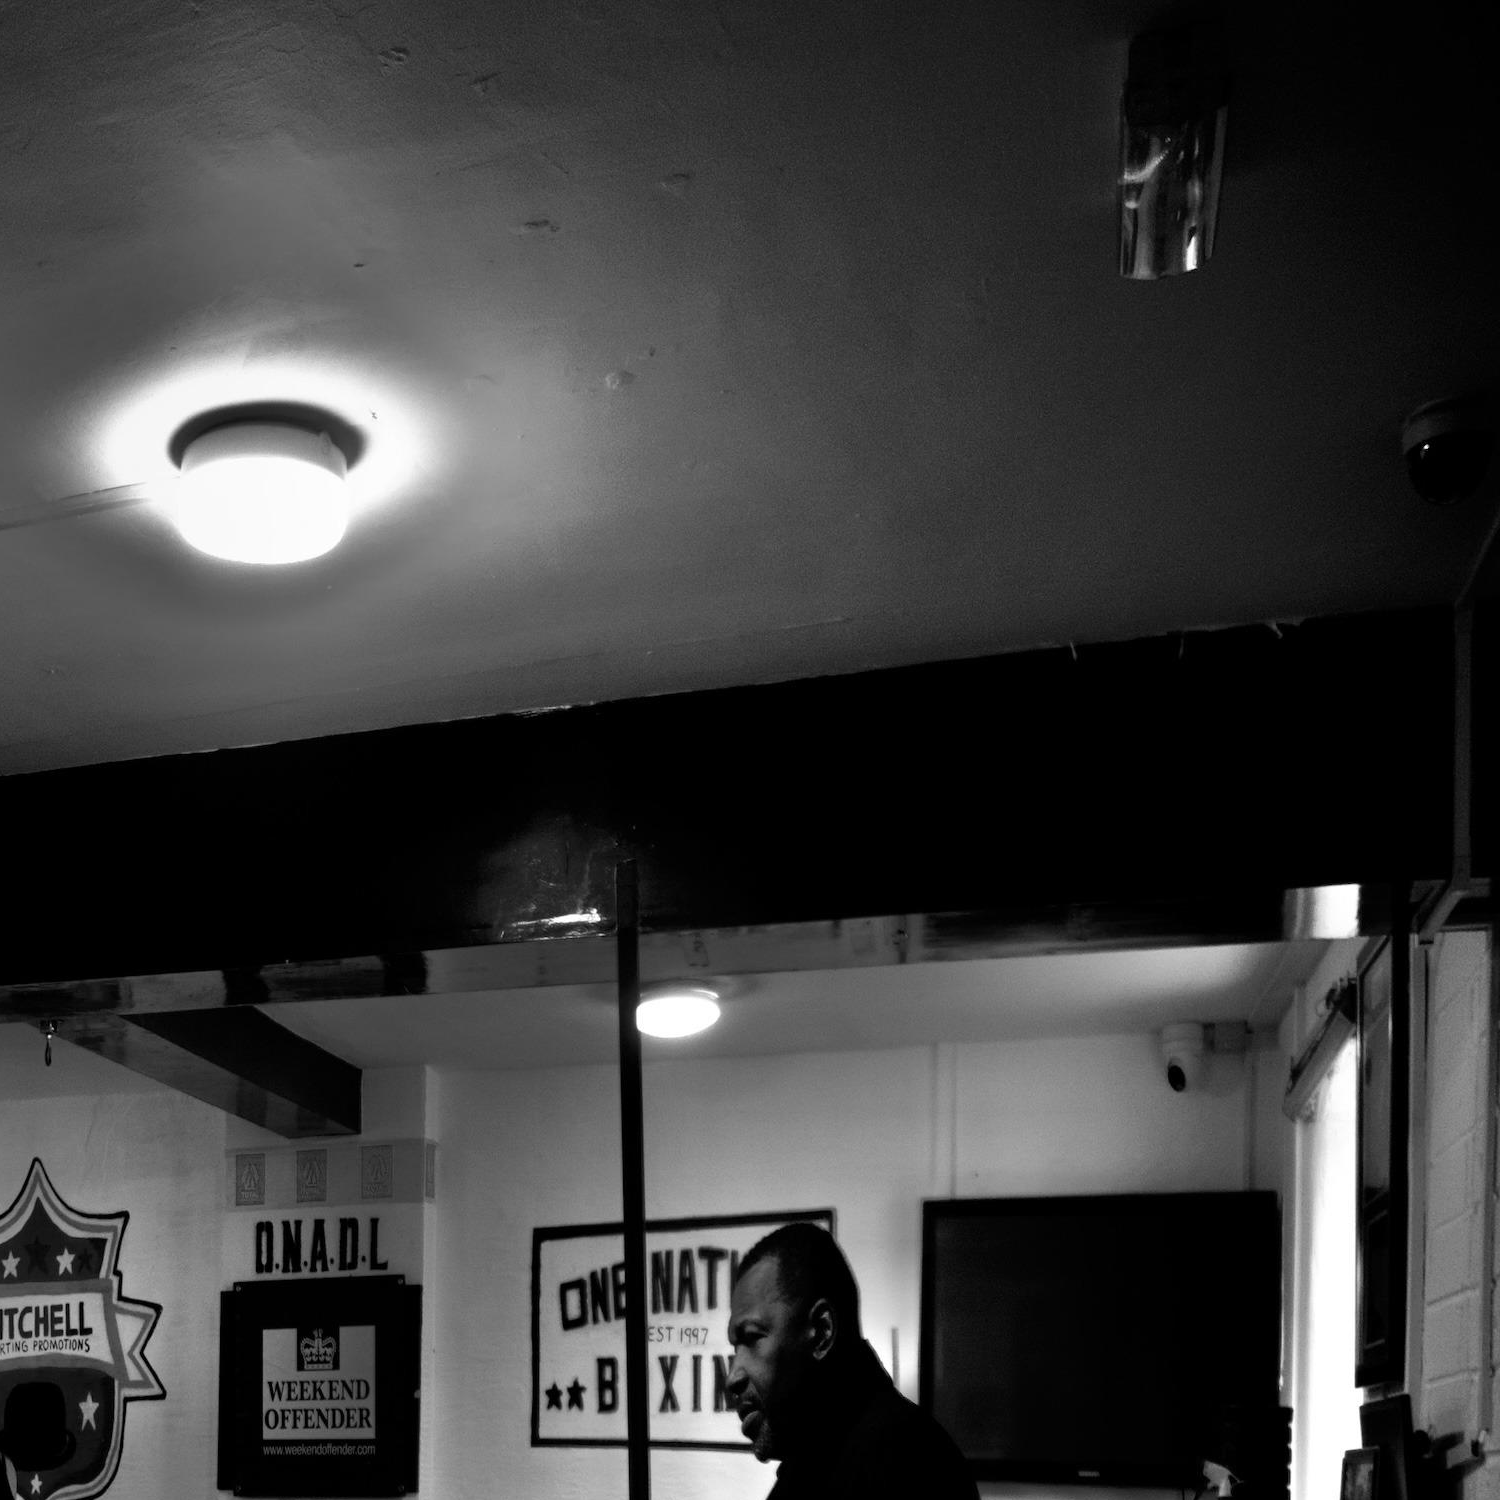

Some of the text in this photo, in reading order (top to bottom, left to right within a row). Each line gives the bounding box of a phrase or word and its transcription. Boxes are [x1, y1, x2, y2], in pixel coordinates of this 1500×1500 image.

[559, 1261, 627, 1331] ONE
[33, 1337, 91, 1354] PROMOTIONS
[647, 1326, 709, 1345] EST 1997
[267, 1378, 371, 1402] WEEKEND
[264, 1406, 373, 1431] OFFENDER
[263, 1443, 376, 1457] www.weekendoffender.com
